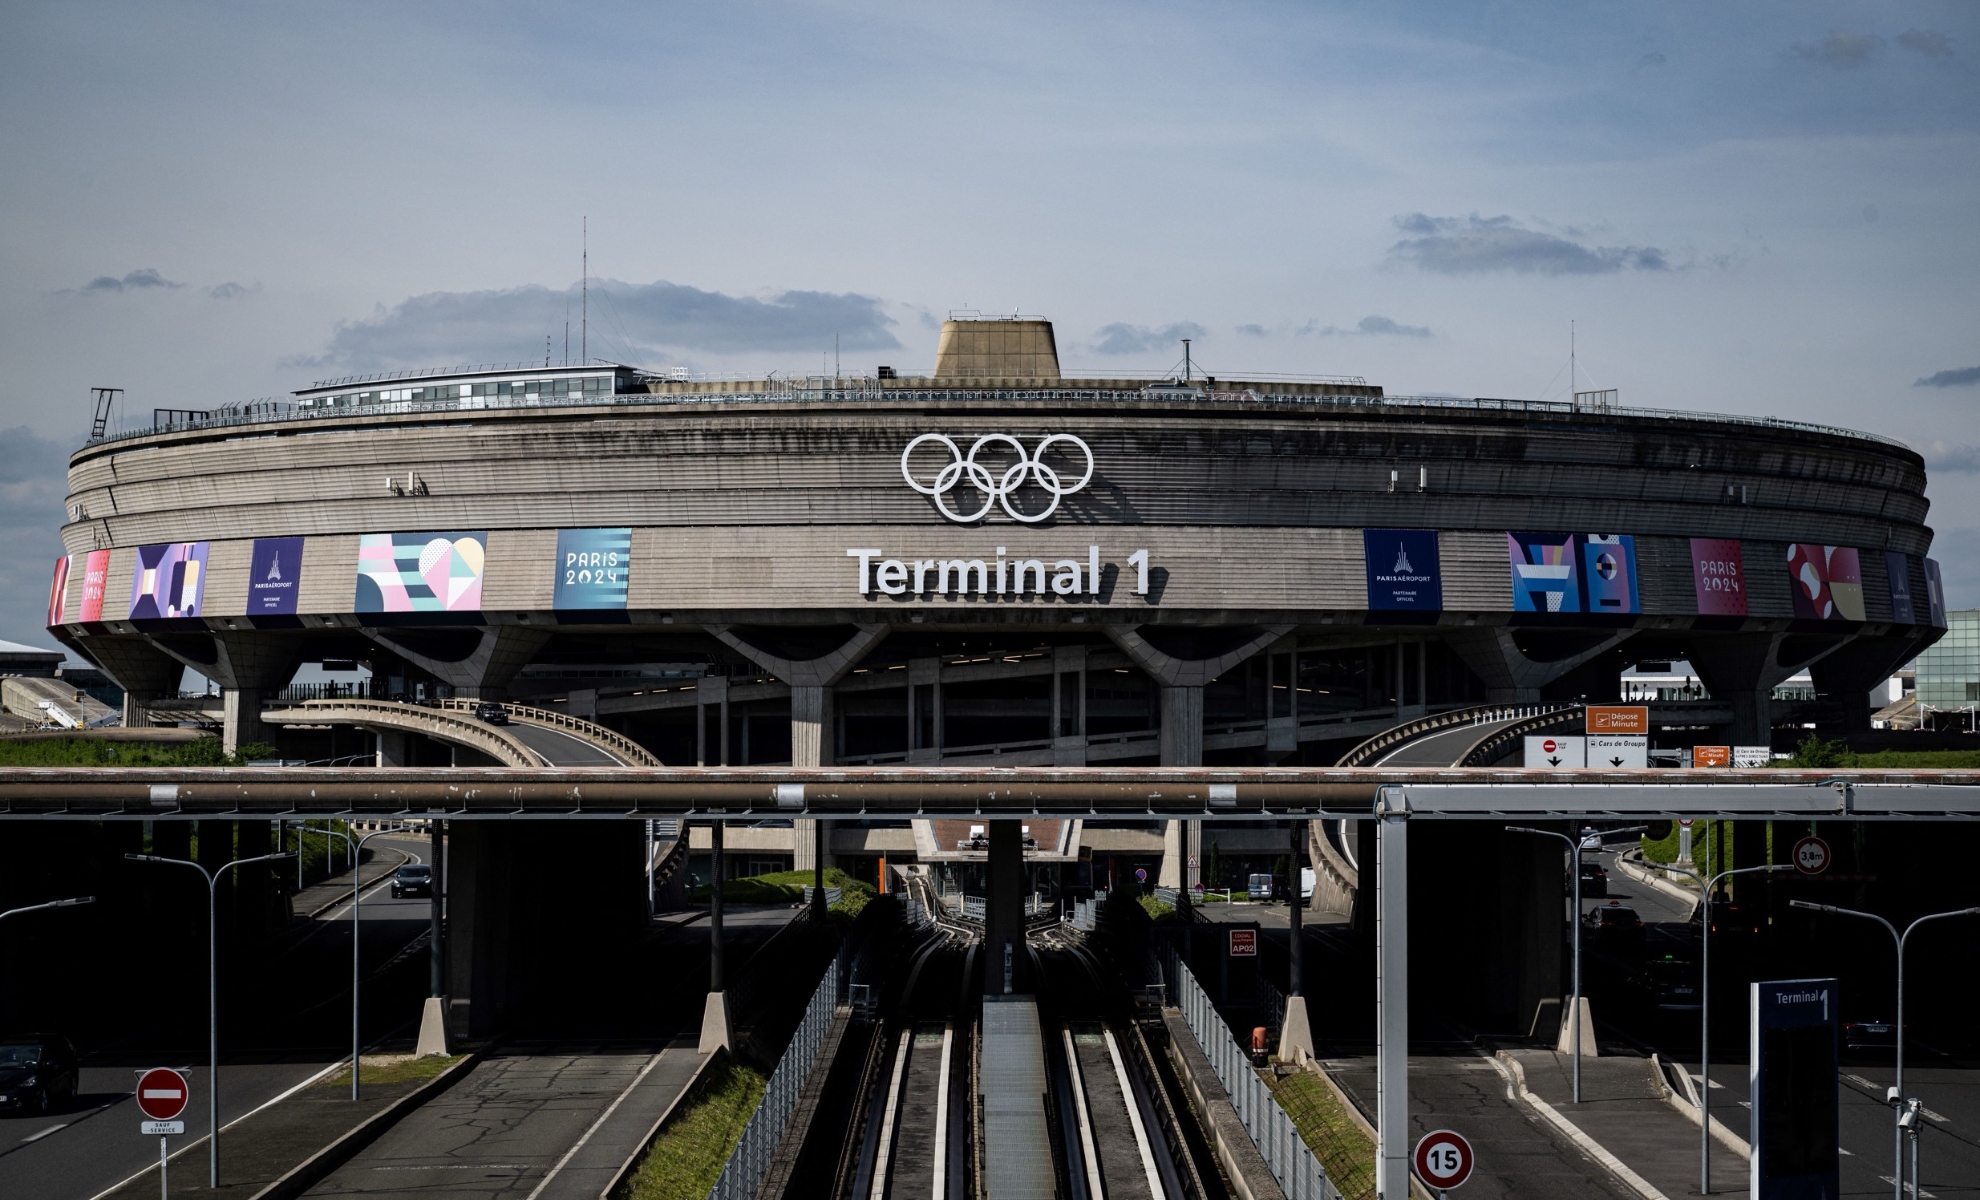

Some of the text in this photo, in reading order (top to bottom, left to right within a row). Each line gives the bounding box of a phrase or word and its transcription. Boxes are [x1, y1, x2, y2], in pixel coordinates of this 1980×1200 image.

[565, 569, 617, 585] 2024
[847, 545, 1148, 595] Terminal 1
[1703, 577, 1739, 592] 2024
[1611, 712, 1639, 721] Dépose
[1611, 720, 1639, 728] Minute
[1623, 740, 1646, 748] Groupe
[1232, 944, 1254, 952] AP02
[1776, 989, 1829, 1021] Terminal 1
[1431, 1150, 1458, 1170] 15
